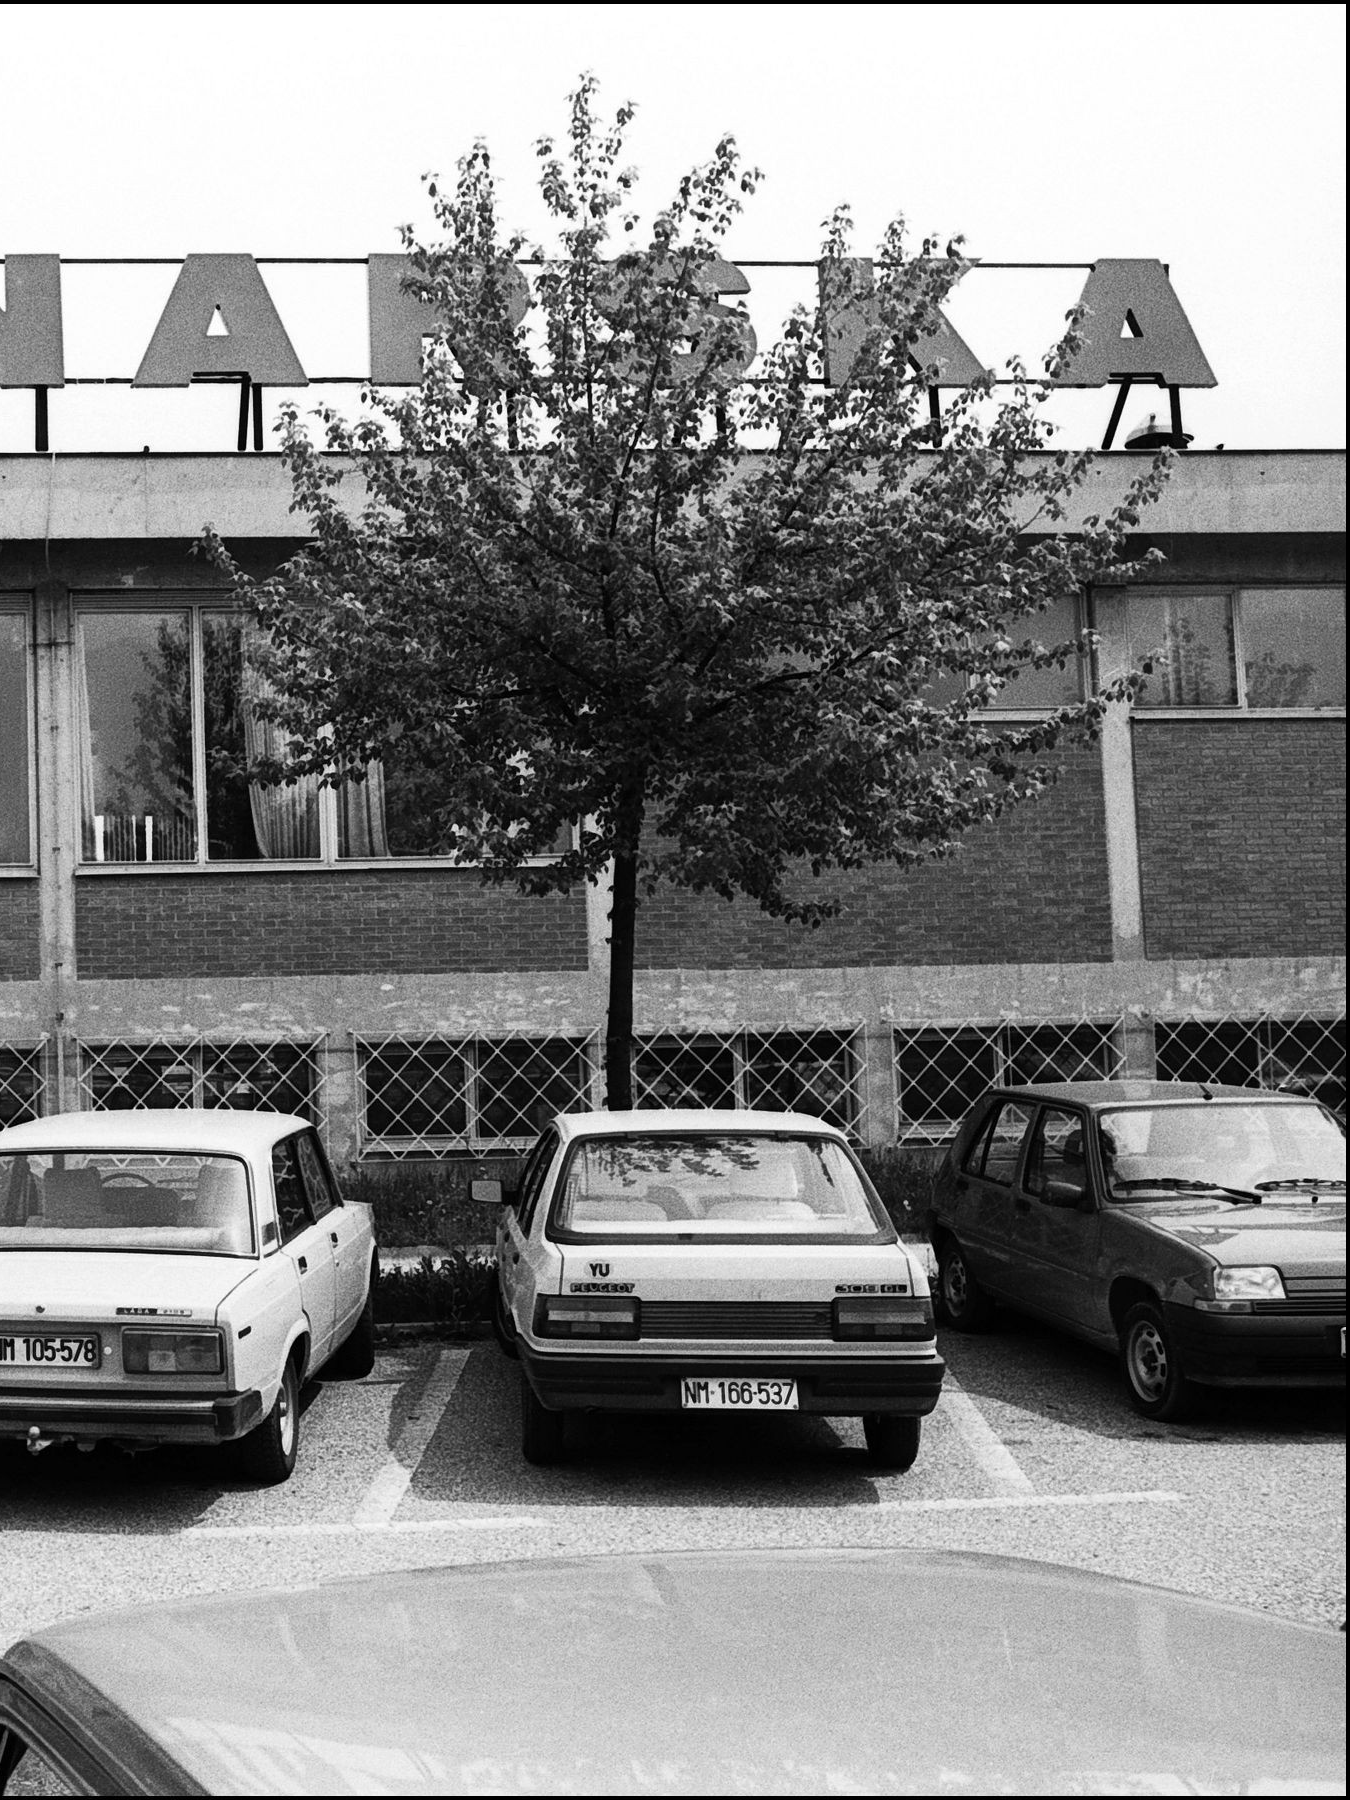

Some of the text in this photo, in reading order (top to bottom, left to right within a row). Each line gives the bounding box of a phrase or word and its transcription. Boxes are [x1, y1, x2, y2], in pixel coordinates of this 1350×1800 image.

[588, 1263, 611, 1278] YU
[570, 1282, 636, 1294] PEUGEOT
[22, 1338, 97, 1363] 105-578
[684, 1381, 795, 1406] NM 166-537
